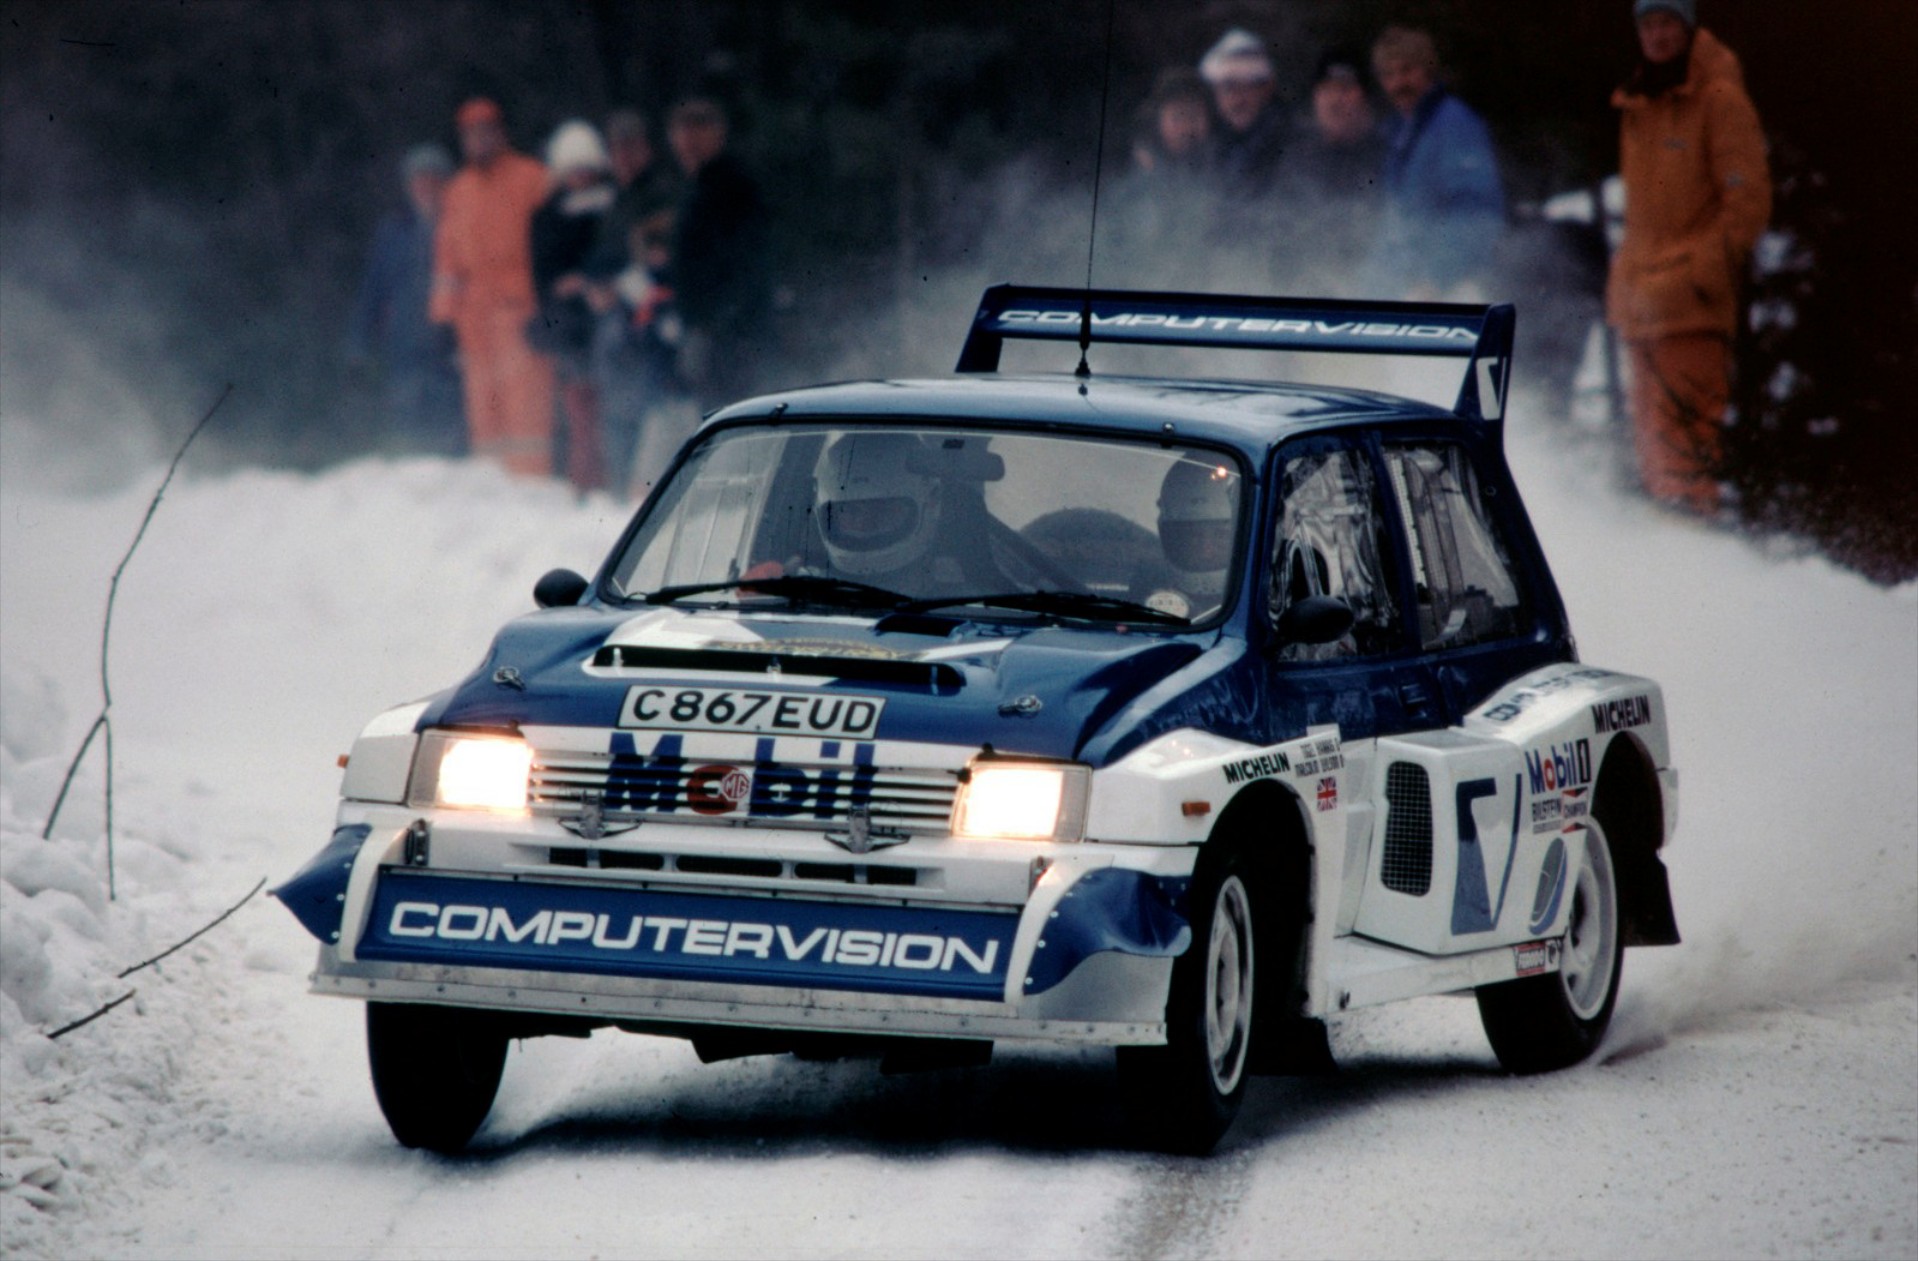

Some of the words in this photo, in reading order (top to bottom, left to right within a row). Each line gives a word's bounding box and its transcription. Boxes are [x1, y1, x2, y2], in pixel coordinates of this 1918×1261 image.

[998, 308, 1480, 342] COMPUTERVISION
[633, 690, 877, 733] C867EUD
[1592, 695, 1652, 734] MICHELIN
[602, 732, 876, 818] Mobil
[723, 774, 749, 800] MG
[1222, 752, 1291, 784] MICHELIN
[1525, 741, 1577, 795] Mobil
[388, 901, 998, 974] COMPUTERVISION
